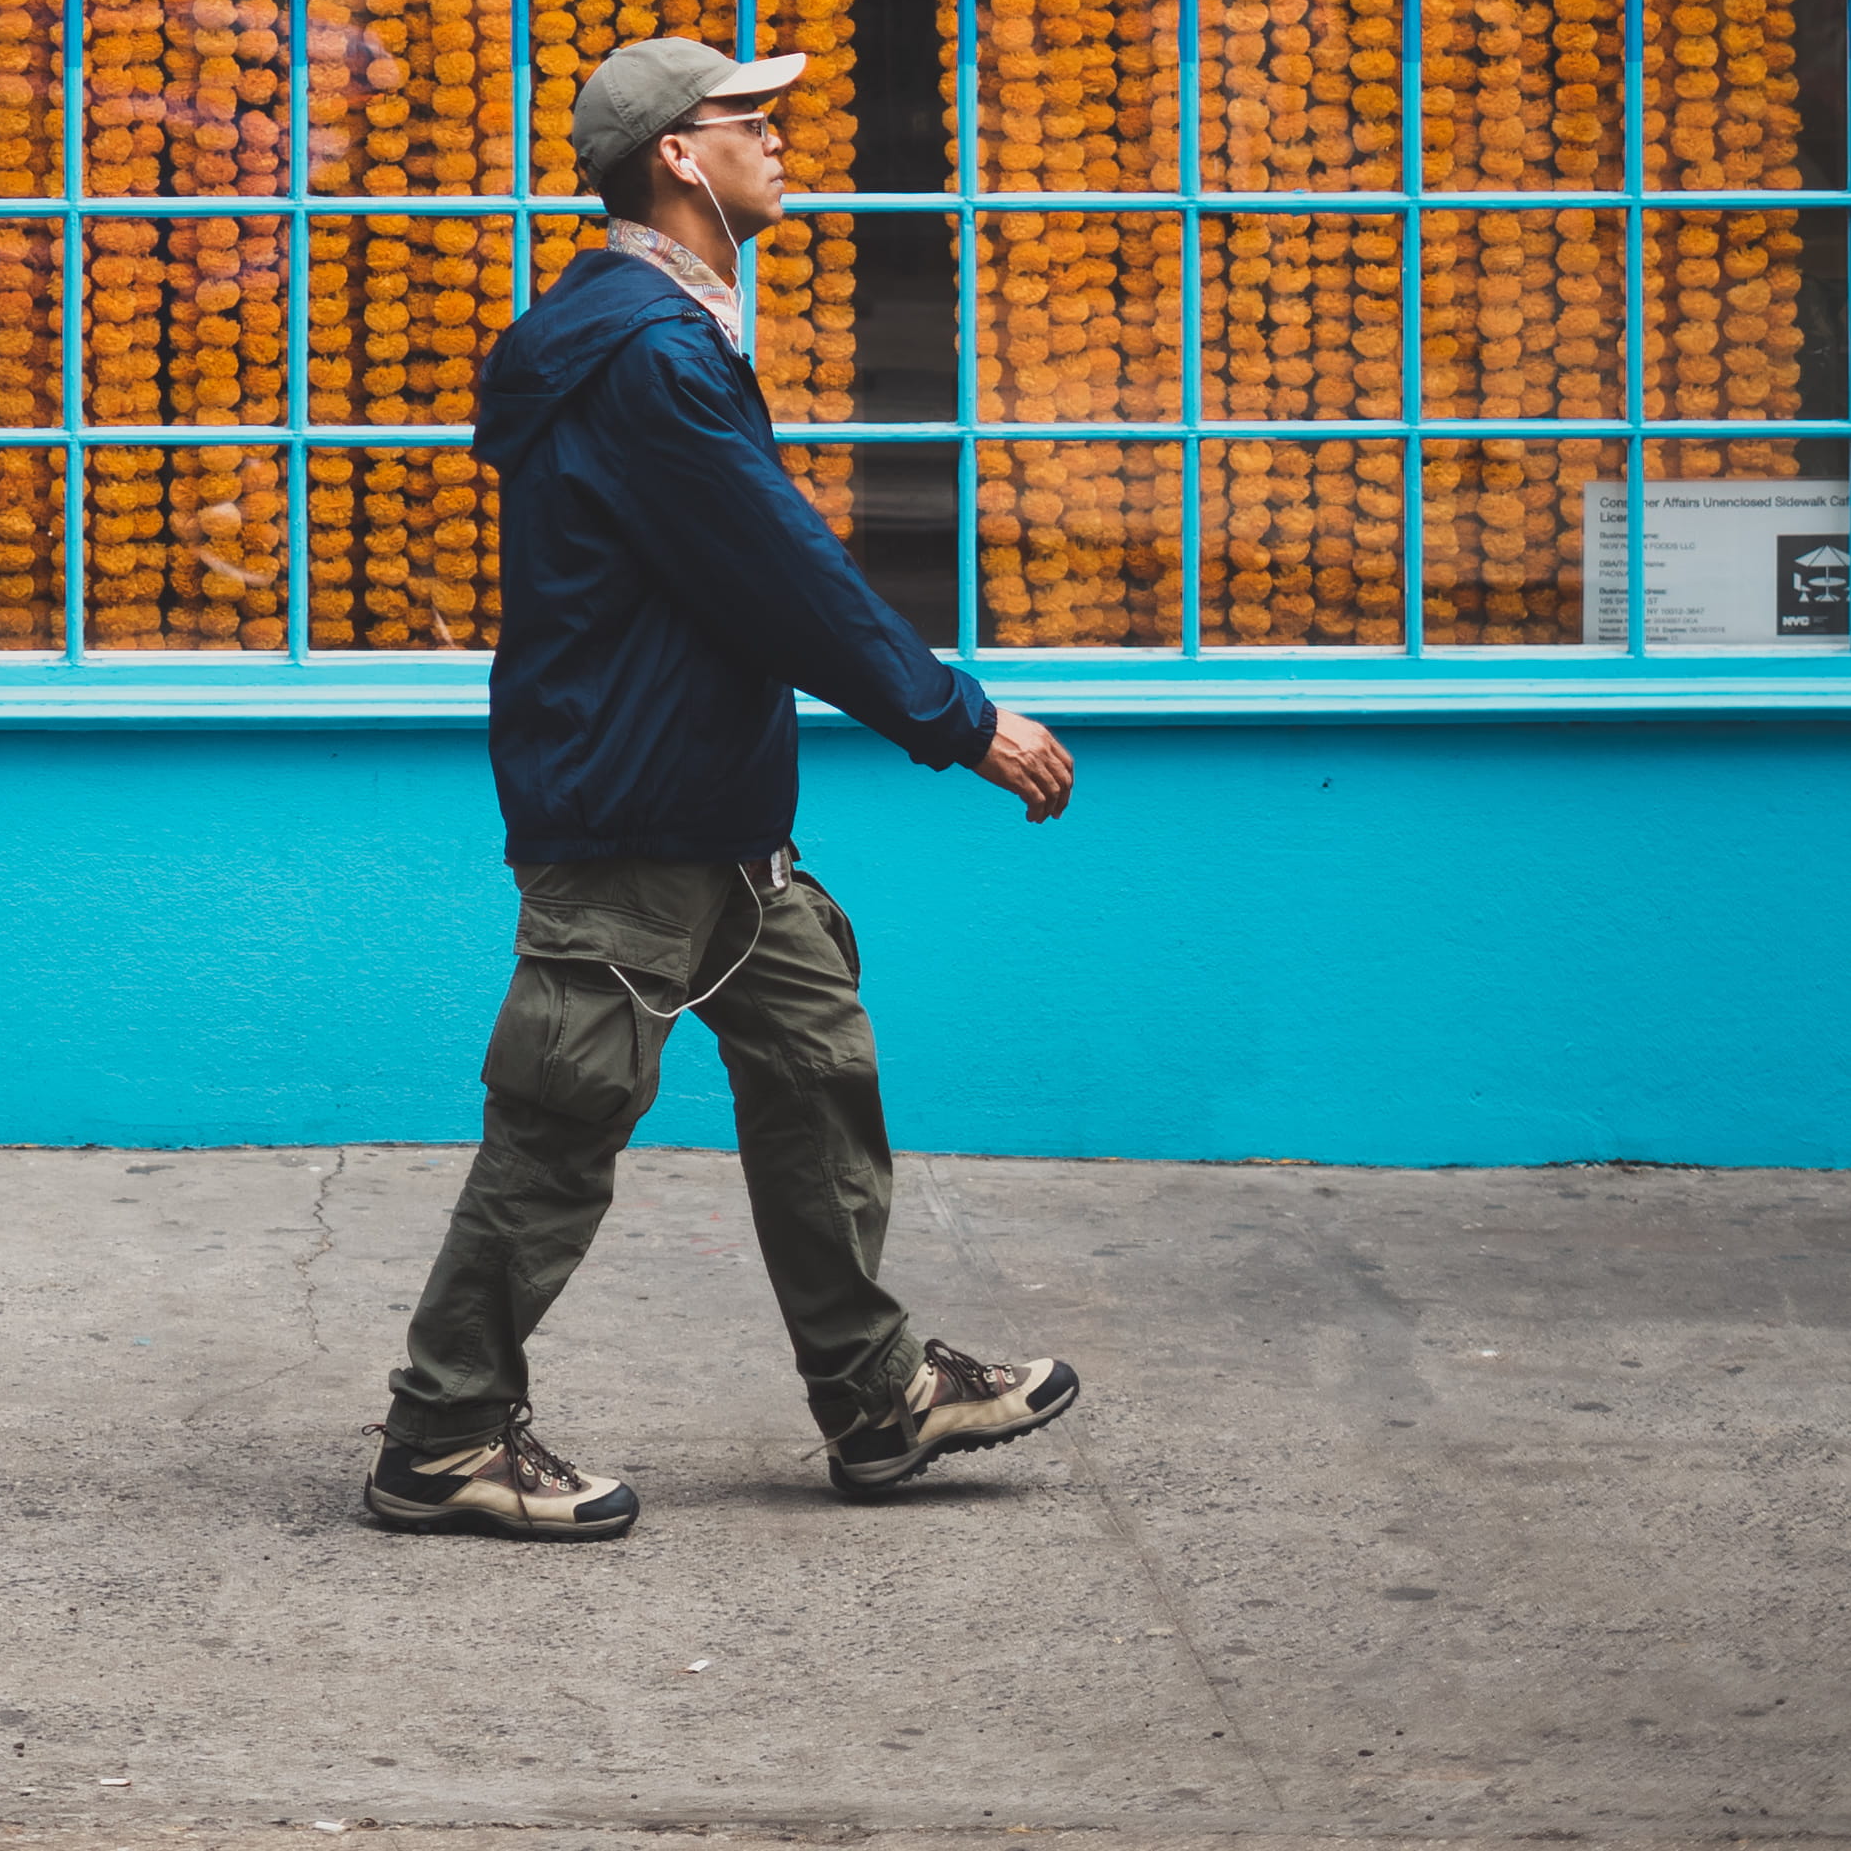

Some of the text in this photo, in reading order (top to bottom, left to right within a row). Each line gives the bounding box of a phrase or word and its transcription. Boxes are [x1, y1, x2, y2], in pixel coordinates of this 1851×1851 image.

[1599, 494, 1850, 509] Consmer Affairs Unenclosed Sidewalk Caf
[1782, 615, 1810, 626] NYC
